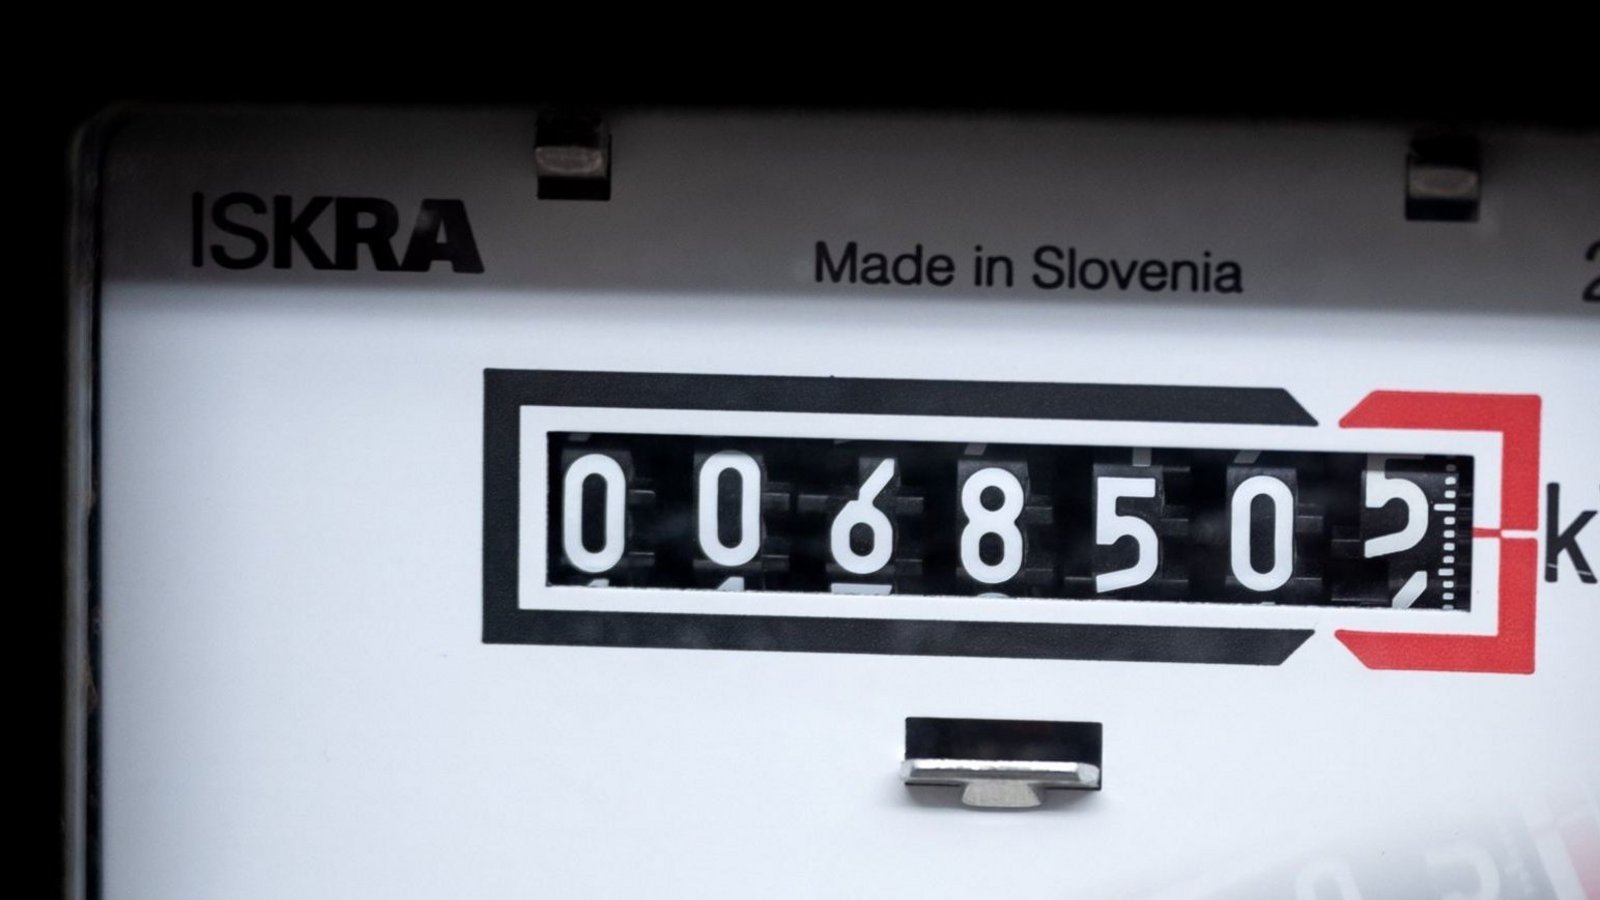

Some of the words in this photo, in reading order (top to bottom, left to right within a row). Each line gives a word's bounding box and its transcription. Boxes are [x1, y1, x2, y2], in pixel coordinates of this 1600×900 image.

[192, 192, 485, 274] ISKRA
[815, 241, 955, 285] Made
[974, 245, 1014, 287] in
[1032, 245, 1243, 294] Slovenia
[1545, 482, 1600, 584] k
